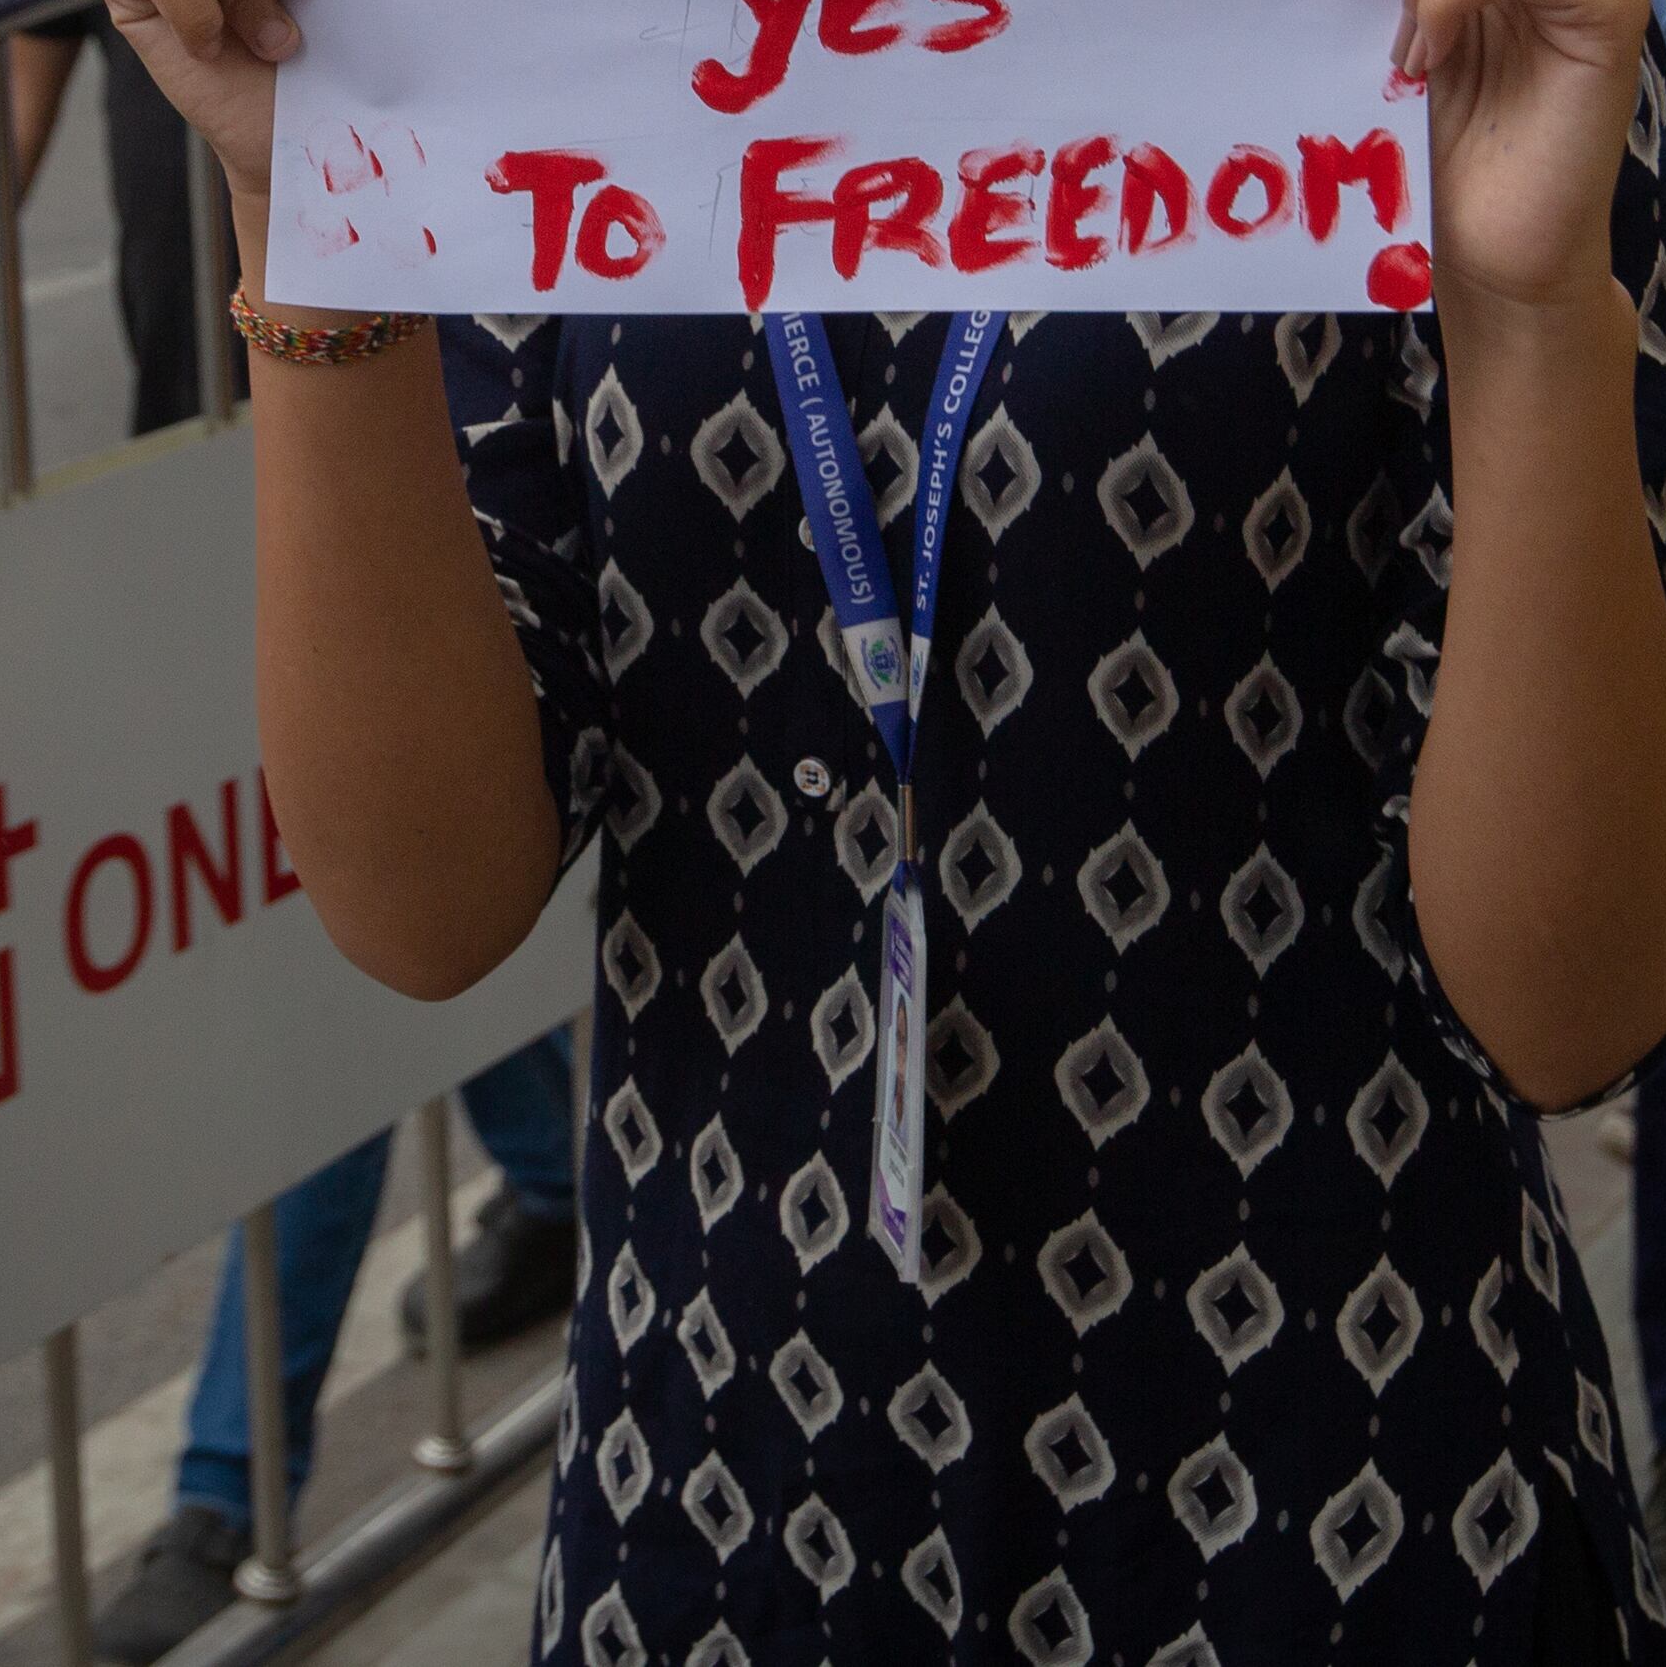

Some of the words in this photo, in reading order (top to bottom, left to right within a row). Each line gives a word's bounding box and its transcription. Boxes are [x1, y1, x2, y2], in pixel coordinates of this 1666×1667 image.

[738, 129, 1410, 311] FREEDOM
[807, 413, 876, 605] AUTONOMOUS)
[916, 570, 931, 611] ST.
